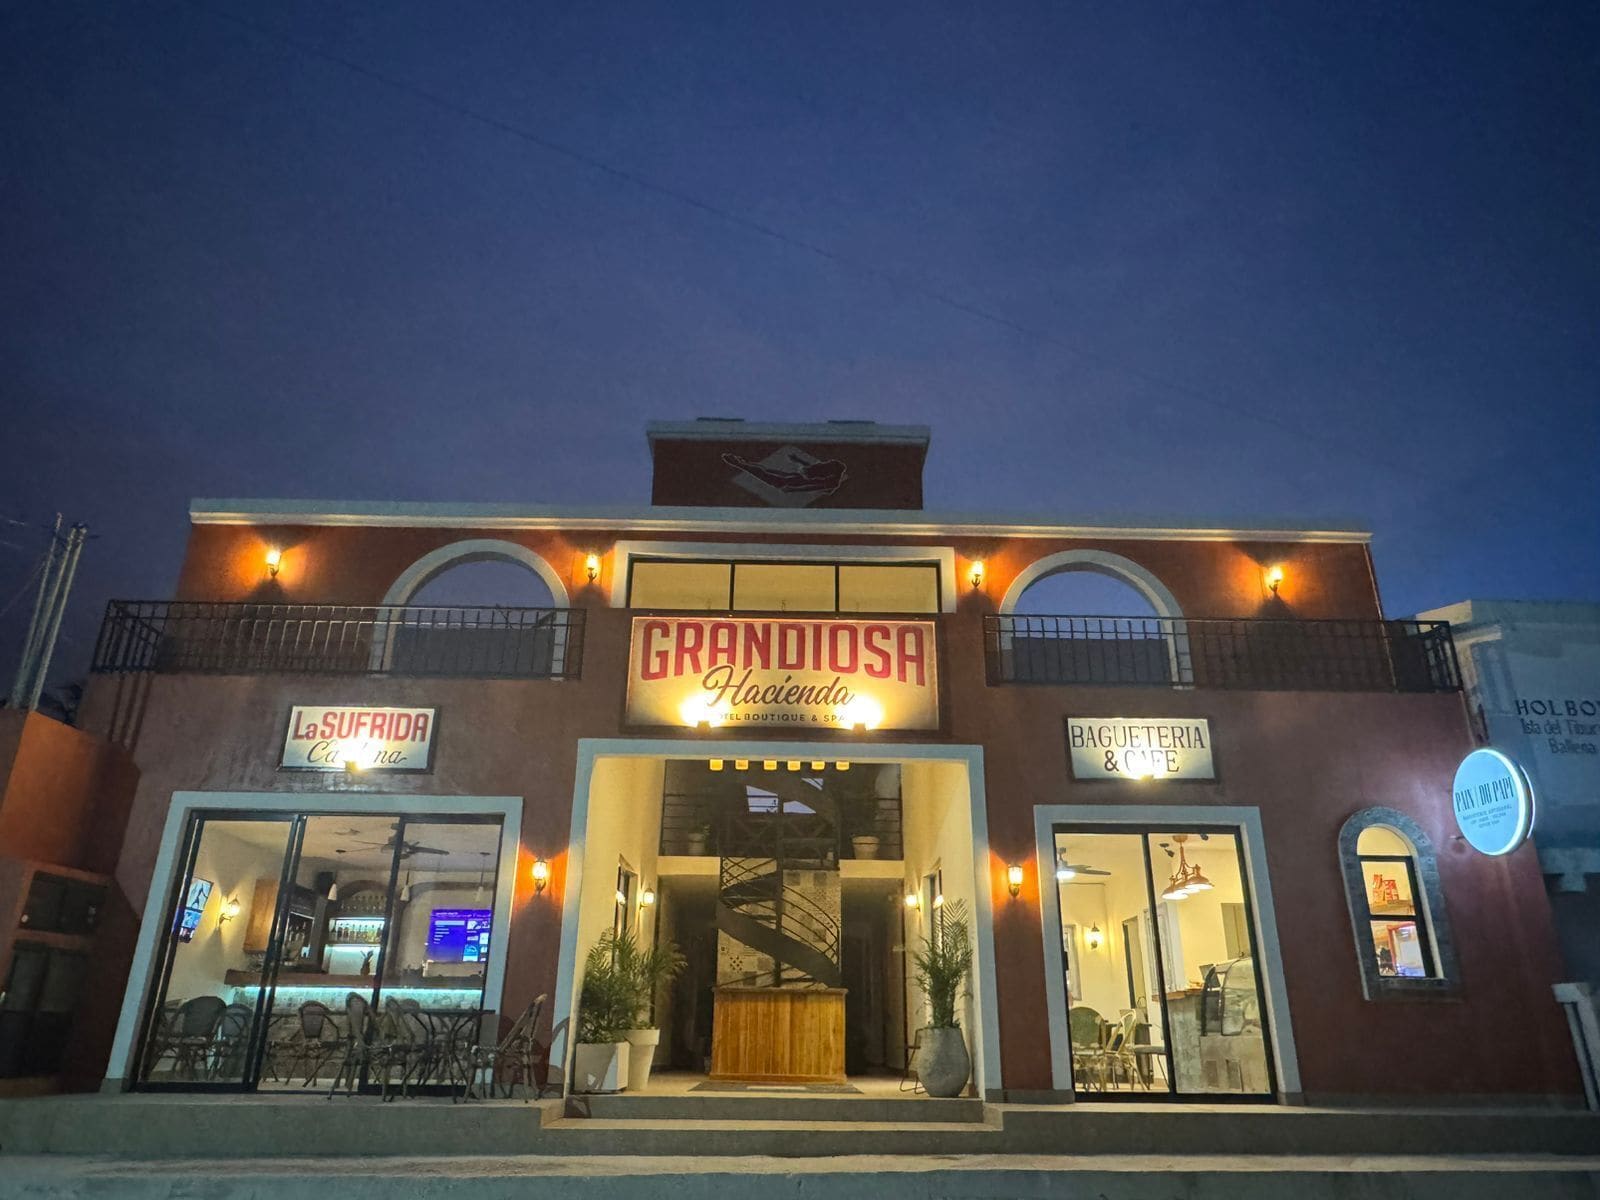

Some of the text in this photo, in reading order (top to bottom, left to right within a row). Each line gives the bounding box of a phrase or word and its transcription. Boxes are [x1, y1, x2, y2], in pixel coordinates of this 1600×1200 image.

[641, 620, 926, 686] GRANDIOSA
[702, 665, 855, 707] Hacienda
[744, 713, 805, 722] BOUTIQUE
[811, 713, 818, 722] &
[1515, 699, 1600, 716] HOLBO
[292, 711, 430, 742] La SUFRIDA
[1070, 725, 1206, 749] BAGUETERIA
[306, 739, 408, 765] Cana
[1104, 750, 1119, 772] &
[1479, 782, 1493, 806] DU
[1492, 776, 1514, 802] PAPI
